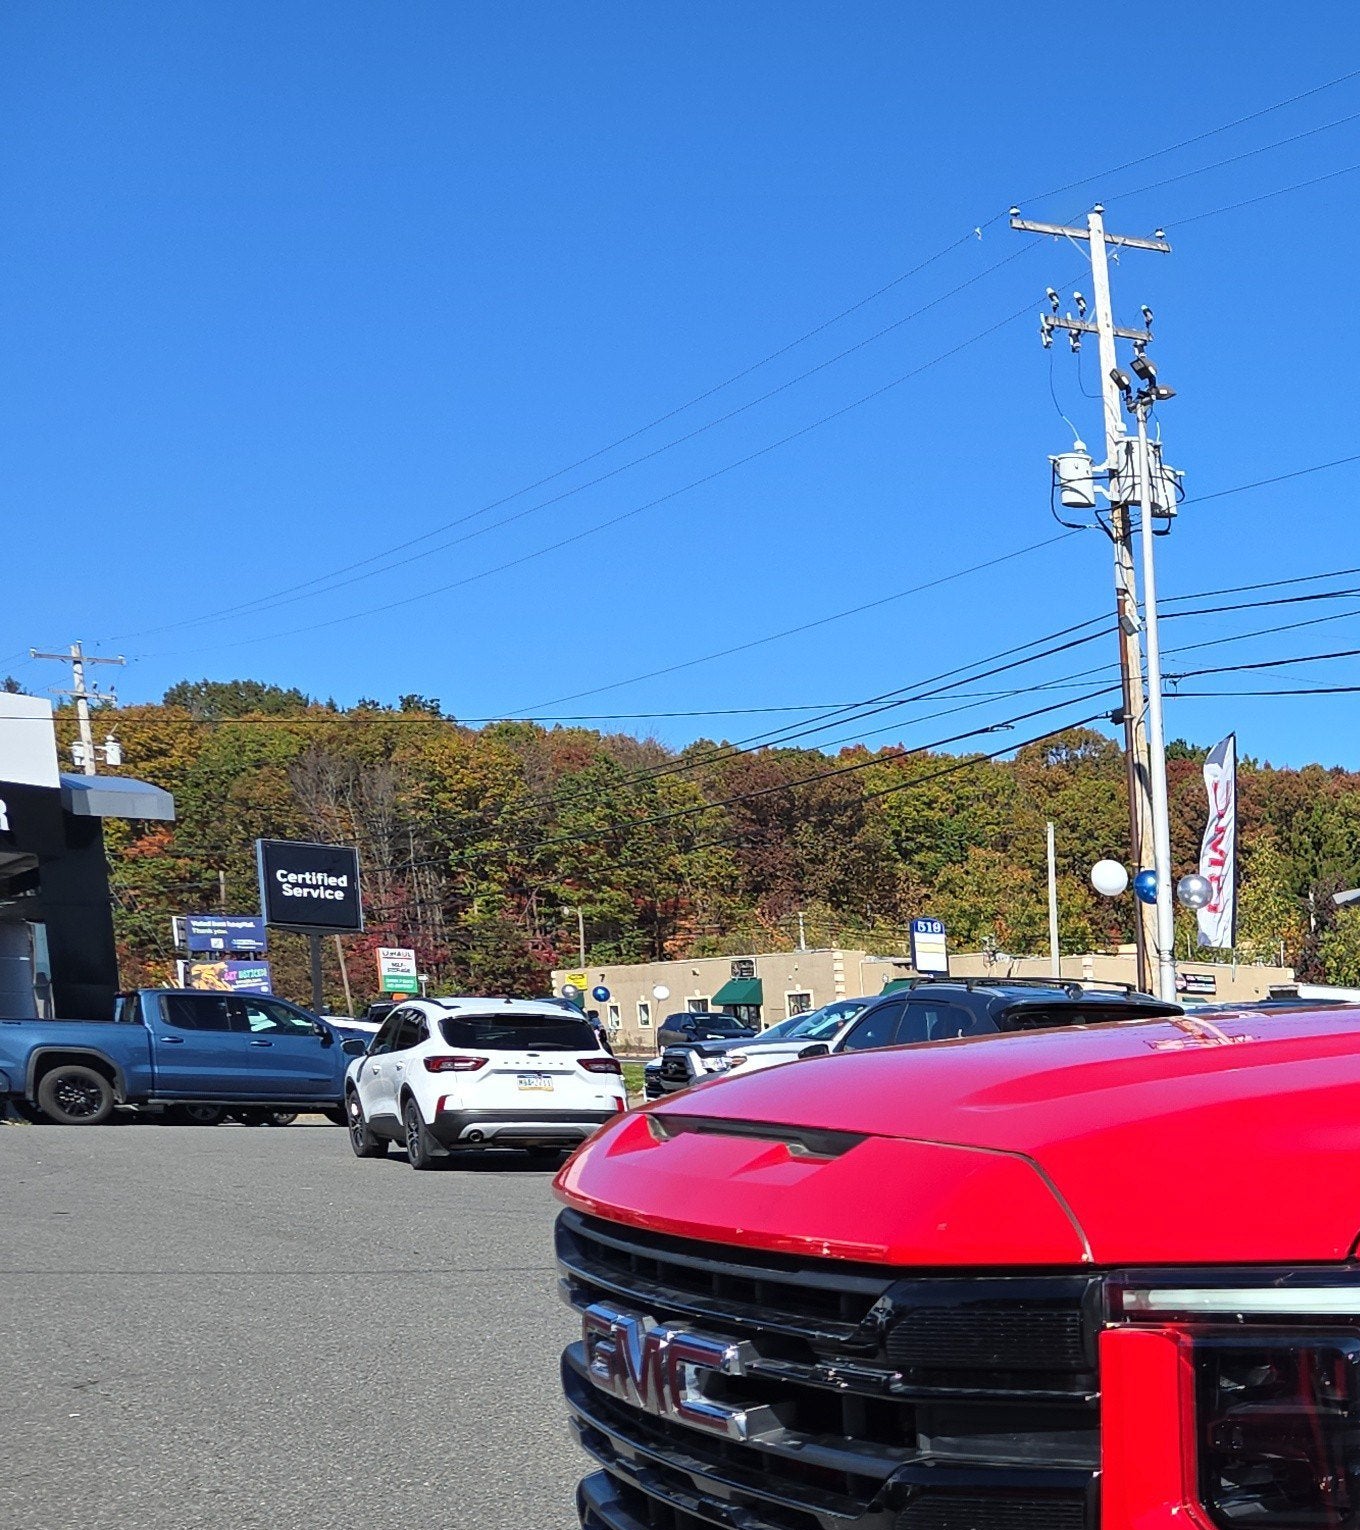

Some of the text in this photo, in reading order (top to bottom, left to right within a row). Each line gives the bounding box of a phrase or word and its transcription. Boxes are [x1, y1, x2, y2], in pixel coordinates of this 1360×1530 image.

[276, 869, 348, 887] Certified
[282, 883, 345, 900] Service
[918, 921, 941, 933] 519
[583, 1303, 752, 1441] GMC
